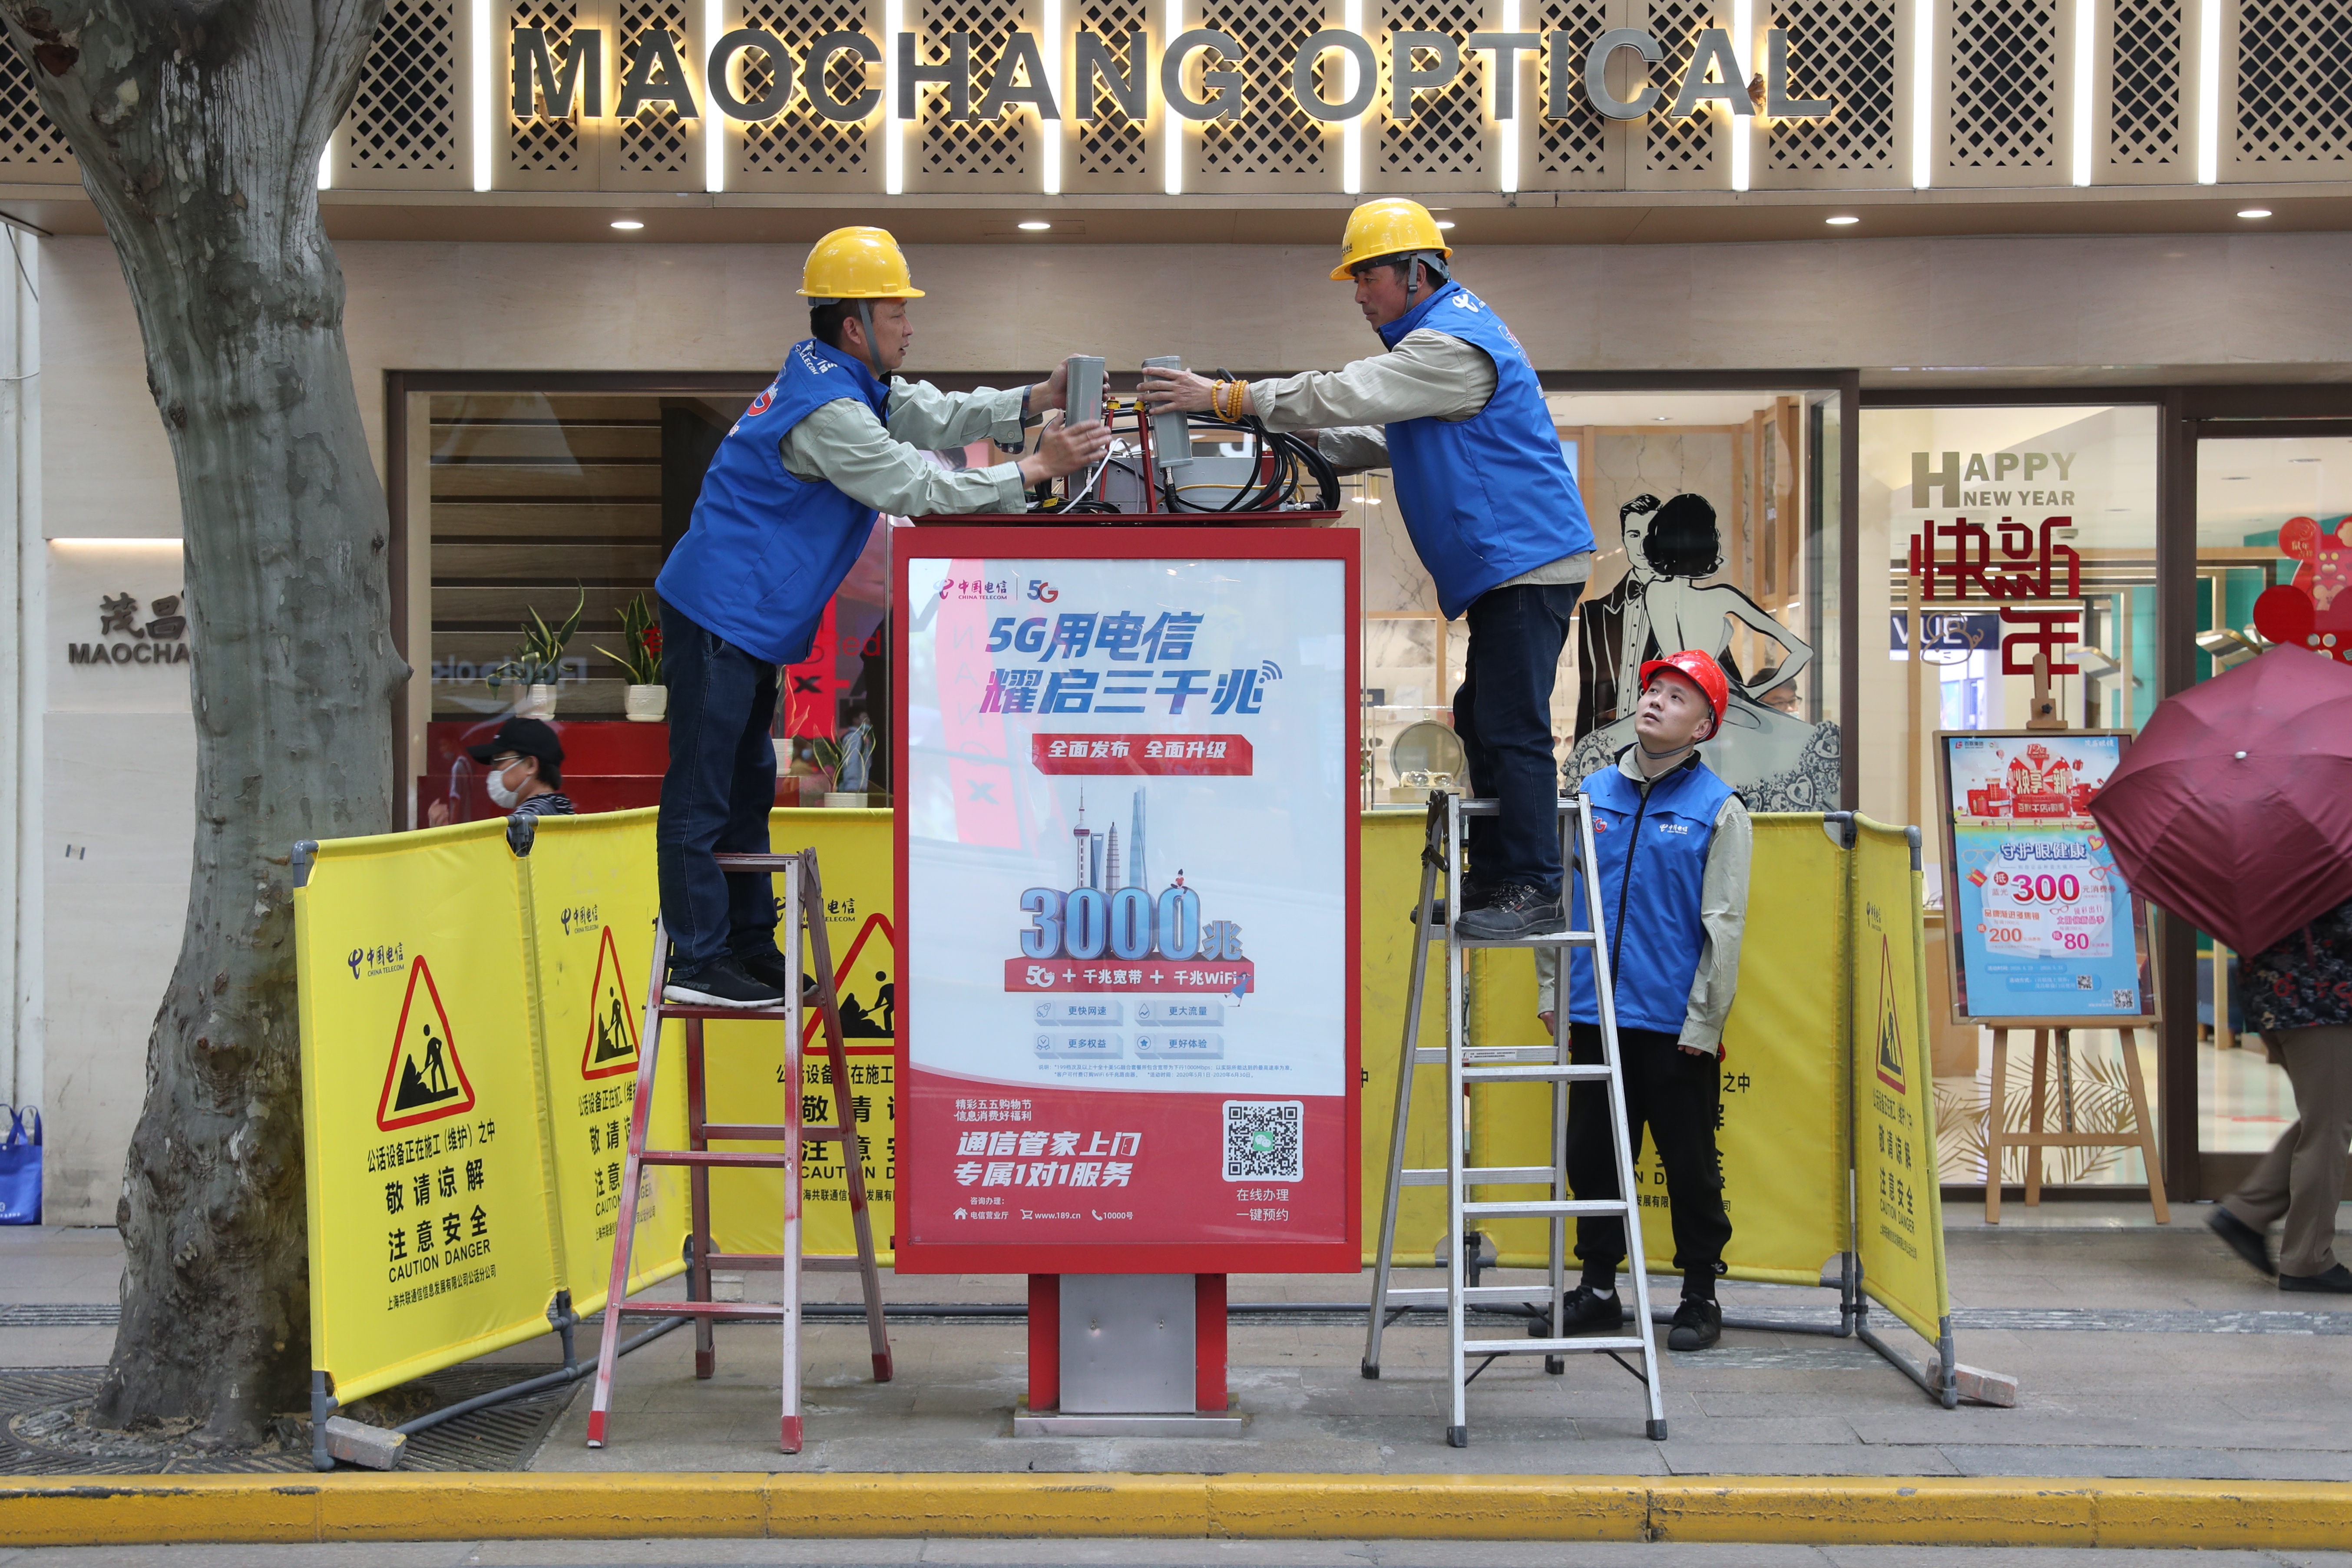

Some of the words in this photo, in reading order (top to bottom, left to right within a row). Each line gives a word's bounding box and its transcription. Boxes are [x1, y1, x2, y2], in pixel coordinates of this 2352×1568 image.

[512, 27, 1242, 121] MAOCHANG
[1292, 27, 1832, 121] OPTICAL
[1911, 452, 2077, 508] HAPPY
[1963, 491, 2013, 506] NEW
[2018, 491, 2075, 506] YEAR
[958, 579, 1007, 595] 中国电信
[1026, 579, 1059, 604] 5G
[984, 610, 1205, 664] 5G用电信
[979, 668, 1264, 715] 耀启三千兆
[1047, 740, 1130, 759] 全面发布
[1144, 740, 1227, 759] 全面升级
[2001, 843, 2087, 860] 守护眼健康
[2011, 873, 2080, 902] 300
[573, 904, 599, 926] 中国电信
[1989, 928, 2022, 942] 200
[2064, 933, 2089, 950] 80
[367, 942, 404, 970] 中国电信
[367, 969, 382, 977] CHINA
[383, 963, 405, 974] TELECOM
[1083, 969, 1142, 986] 千兆宽带
[1174, 969, 1237, 986] 千兆WiFi
[1068, 1006, 1107, 1016] 更快网速
[1168, 1006, 1207, 1016] 更大流量
[1068, 1039, 1107, 1049] 更多权益
[1168, 1039, 1207, 1049] 更好体验
[955, 1098, 1032, 1111] 精彩五五购物节
[953, 1110, 1032, 1122] 信息消费好福利
[956, 1131, 1142, 1158] 通信管家上门
[953, 1161, 1134, 1187] 专属1对1服务
[385, 1158, 485, 1215] 敬请谅解
[1236, 1188, 1290, 1202] 在线办理
[970, 1211, 1009, 1220] 电信营业厅
[1034, 1211, 1082, 1221] www.189.cn
[1102, 1211, 1134, 1220] 10000号
[1236, 1207, 1289, 1222] 一键预约
[387, 1204, 488, 1263] 注意安全
[389, 1254, 439, 1283] CAUTION
[445, 1239, 491, 1266] DANGER
